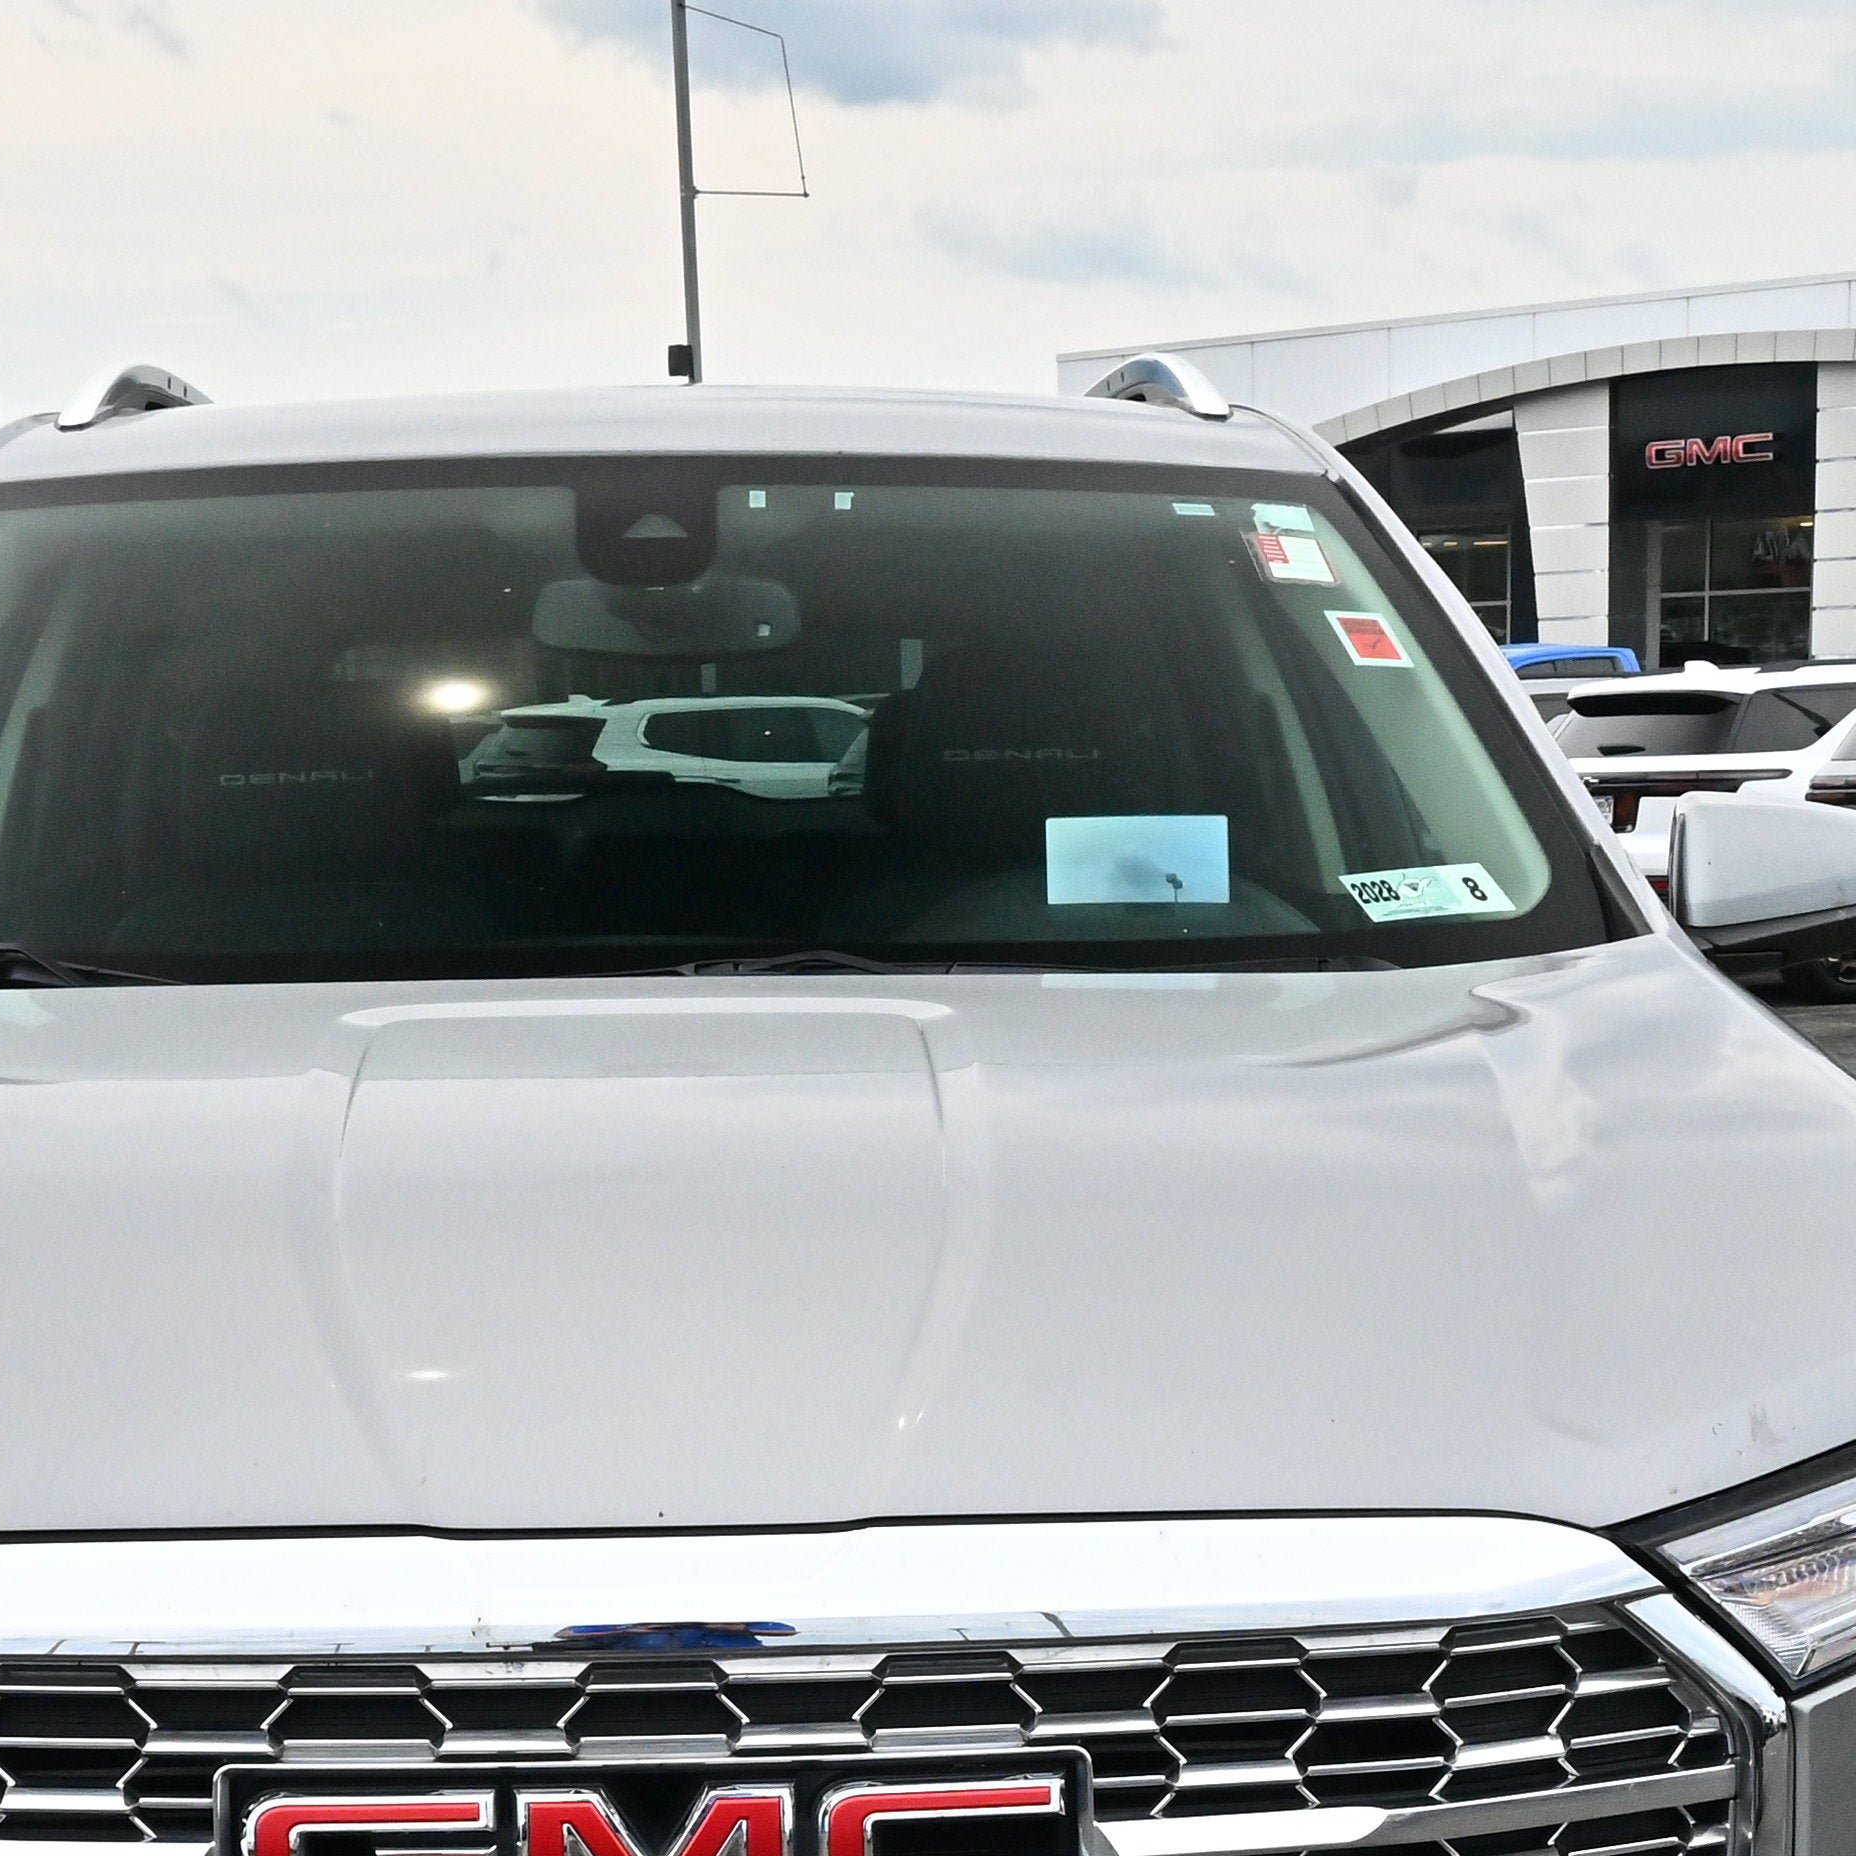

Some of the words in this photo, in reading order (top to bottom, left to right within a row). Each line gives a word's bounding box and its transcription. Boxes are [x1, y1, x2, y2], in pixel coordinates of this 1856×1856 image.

[1645, 432, 1774, 469] GMC
[944, 749, 1098, 761] DENALI
[219, 770, 374, 786] DENALI
[1350, 879, 1401, 904] 2028
[1461, 877, 1488, 902] 8
